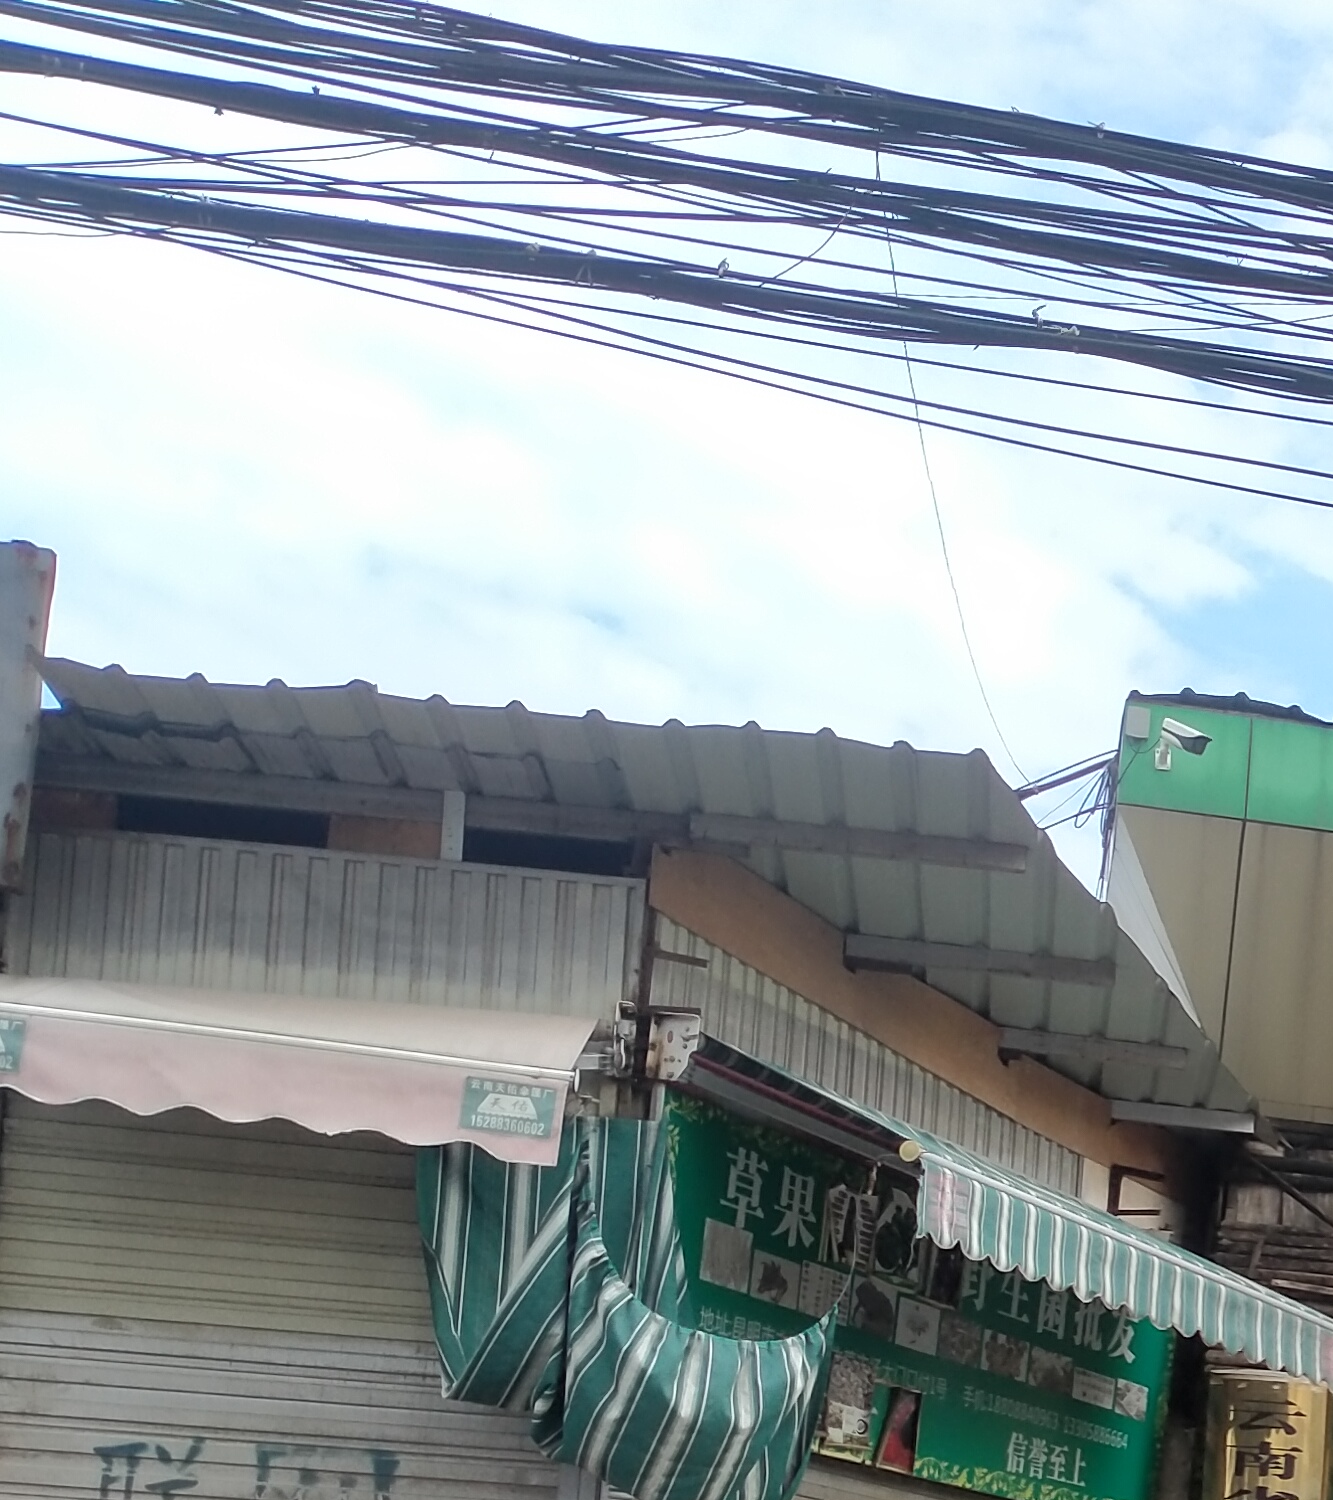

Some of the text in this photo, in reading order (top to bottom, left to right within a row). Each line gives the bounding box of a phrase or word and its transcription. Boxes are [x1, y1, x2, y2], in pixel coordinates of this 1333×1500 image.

[470, 1114, 545, 1136] 15288360602
[719, 1146, 817, 1248] 草果
[1006, 1431, 1087, 1487] 信誉至上
